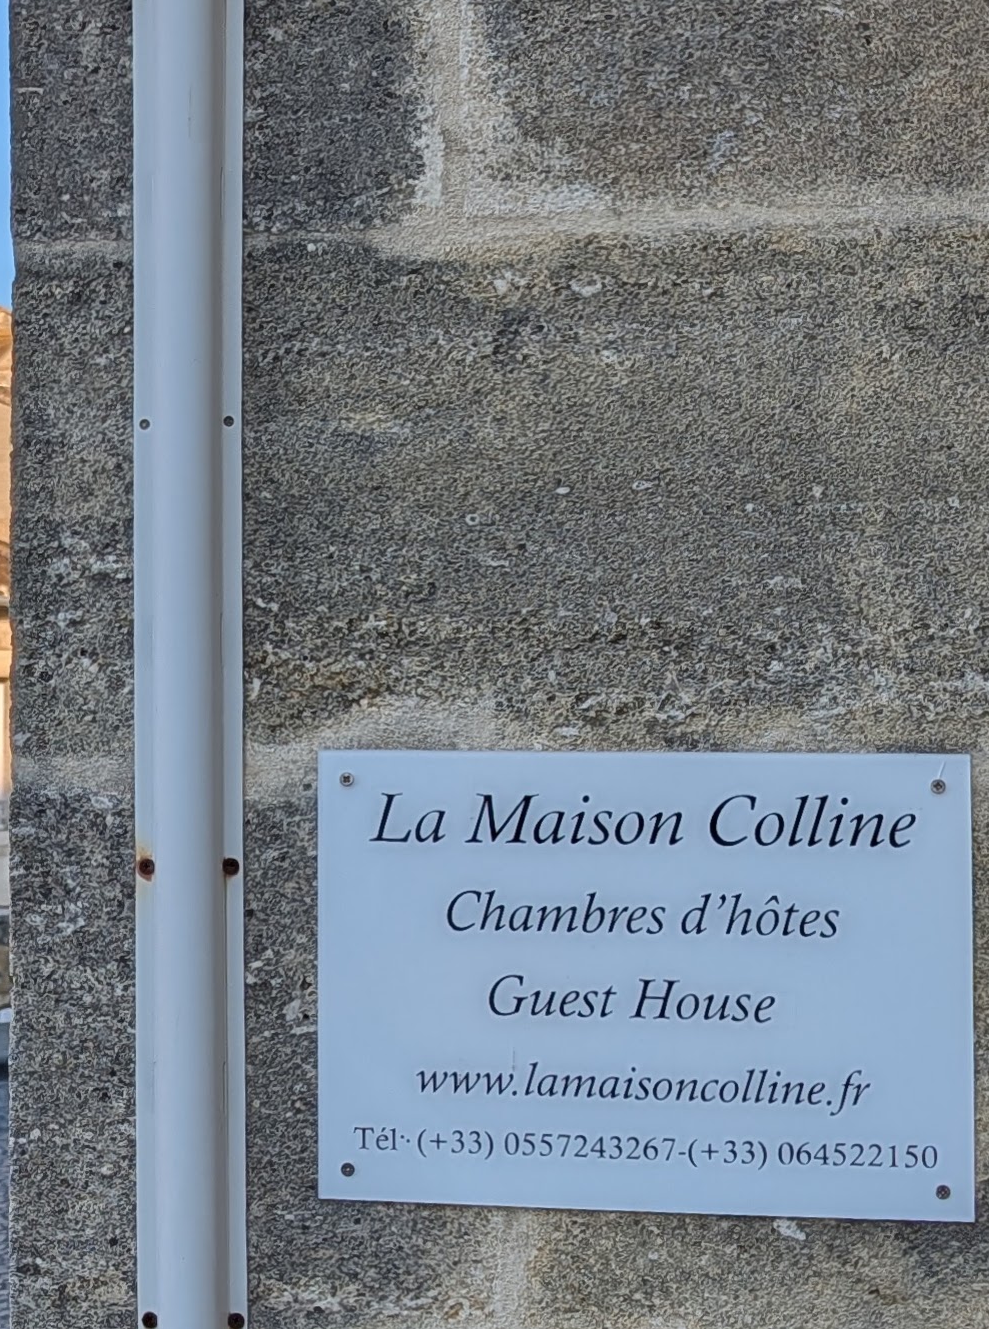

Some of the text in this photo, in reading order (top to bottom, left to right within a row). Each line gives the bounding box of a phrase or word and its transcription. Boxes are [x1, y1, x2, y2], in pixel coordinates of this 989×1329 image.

[368, 792, 917, 849] La Maison Colline
[446, 889, 666, 935] Chambres
[488, 974, 776, 1024] Guest House
[415, 1061, 872, 1117] www.lamaisoncolline.fr
[417, 1128, 494, 1160] (+33)
[777, 1141, 938, 1169] 064522150
